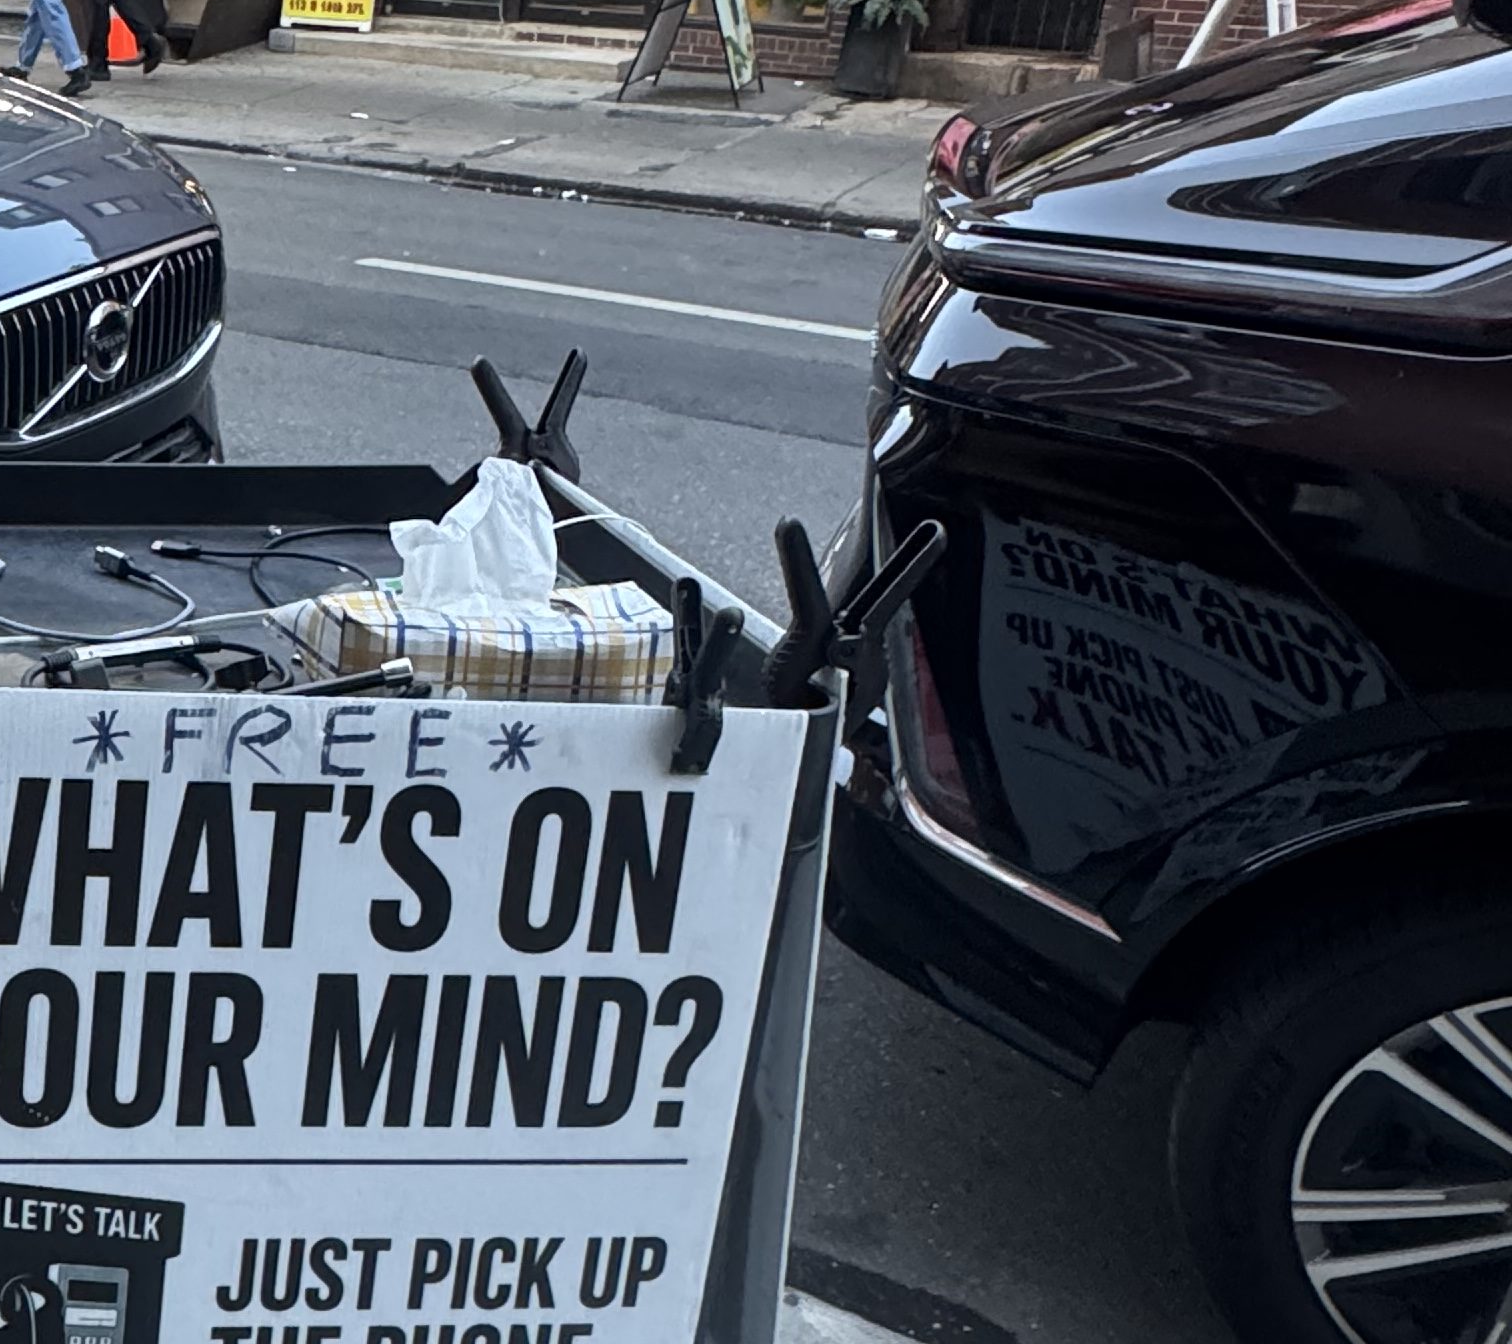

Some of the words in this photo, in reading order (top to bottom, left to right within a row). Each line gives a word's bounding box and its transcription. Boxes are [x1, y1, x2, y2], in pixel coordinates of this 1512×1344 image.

[497, 785, 694, 955] ON
[300, 973, 725, 1130] MIND?
[3, 1197, 84, 1234] LET'S
[95, 1207, 162, 1241] TALK
[216, 1238, 391, 1312] JUST
[407, 1236, 565, 1310] PICK
[578, 1236, 668, 1308] UP
